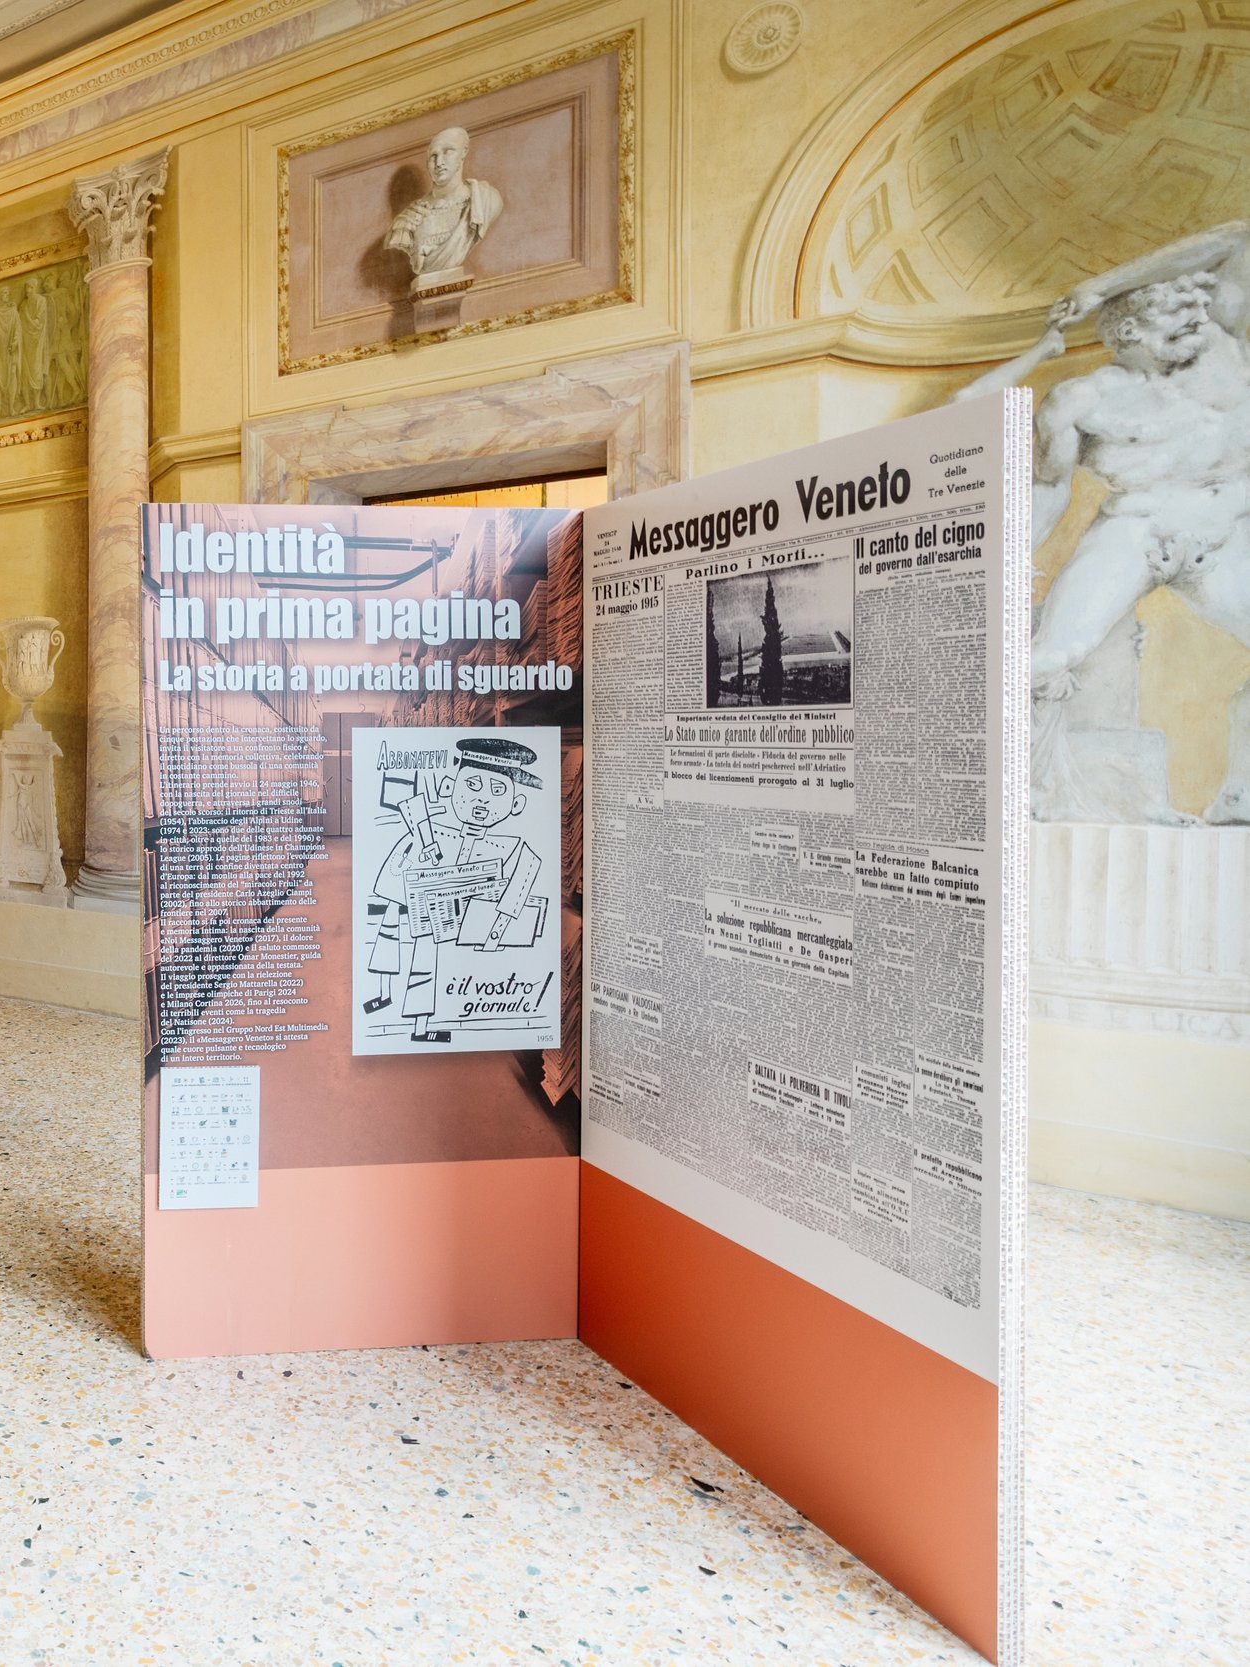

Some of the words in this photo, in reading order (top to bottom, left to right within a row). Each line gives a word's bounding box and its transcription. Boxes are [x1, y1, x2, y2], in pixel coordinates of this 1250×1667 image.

[929, 444, 984, 465] Quotidiano
[944, 465, 967, 478] delle
[928, 488, 944, 499] Tre
[946, 478, 985, 496] Venezie
[629, 498, 779, 560] Messaggero
[795, 461, 911, 523] Veneto
[160, 522, 345, 573] Identità
[856, 538, 864, 559] Il
[870, 532, 908, 556] canto
[915, 524, 936, 548] del
[943, 521, 984, 546] cigno
[686, 563, 738, 579] Parlino
[748, 559, 752, 568] i
[762, 549, 825, 567] Morti...
[859, 562, 871, 575] del
[876, 558, 912, 574] governo
[917, 546, 982, 566] dall'esarchia
[592, 575, 663, 601] TRIESTE
[160, 589, 205, 638] in
[217, 590, 353, 645] prima
[365, 591, 520, 645] pagina
[596, 605, 605, 616] 24
[608, 600, 637, 615] maggio
[641, 596, 658, 609] 1915
[160, 660, 194, 691] La
[198, 660, 283, 691] storia
[291, 664, 308, 691] a
[315, 661, 419, 693] portata
[425, 660, 452, 691] di
[458, 660, 572, 694] sguardo
[665, 726, 673, 741] Lo
[677, 726, 695, 741] Stato
[699, 728, 720, 742] unico
[725, 728, 756, 745] garante
[760, 725, 806, 743] dell'ordine
[812, 725, 854, 747] pubblico
[378, 741, 448, 770] ABBONATEVI
[465, 751, 492, 761] Messaggero
[672, 772, 692, 780] blocco
[696, 773, 706, 781] dei
[710, 774, 754, 783] licenziamenti
[759, 777, 797, 786] prorogato
[802, 778, 809, 786] al
[816, 778, 824, 786] 31
[830, 780, 854, 789] luglio
[856, 851, 865, 861] La
[872, 853, 925, 869] Federazione
[932, 861, 979, 876] Balcanica
[856, 867, 887, 878] sarebbe
[894, 872, 904, 880] un
[910, 872, 929, 884] fatto
[934, 877, 979, 891] compiuto
[705, 908, 711, 921] La
[717, 912, 744, 928] soluzione
[750, 920, 791, 938] repubblicana
[797, 931, 852, 950] mercanteggiata
[720, 928, 741, 941] Nenni
[748, 934, 782, 950] Togliatti
[801, 946, 811, 956] De
[819, 950, 852, 966] Gasperi
[174, 982, 212, 990] presidente
[214, 981, 237, 989] Sergio
[279, 979, 303, 987] (2022)
[446, 977, 456, 994] è
[458, 976, 472, 995] il
[476, 973, 541, 995] vostro
[459, 972, 554, 1017] giornale!
[161, 1037, 187, 1045] (2023),
[177, 1027, 211, 1036] l'ingresso
[161, 1046, 181, 1054] quale
[206, 1045, 237, 1053] pulsante
